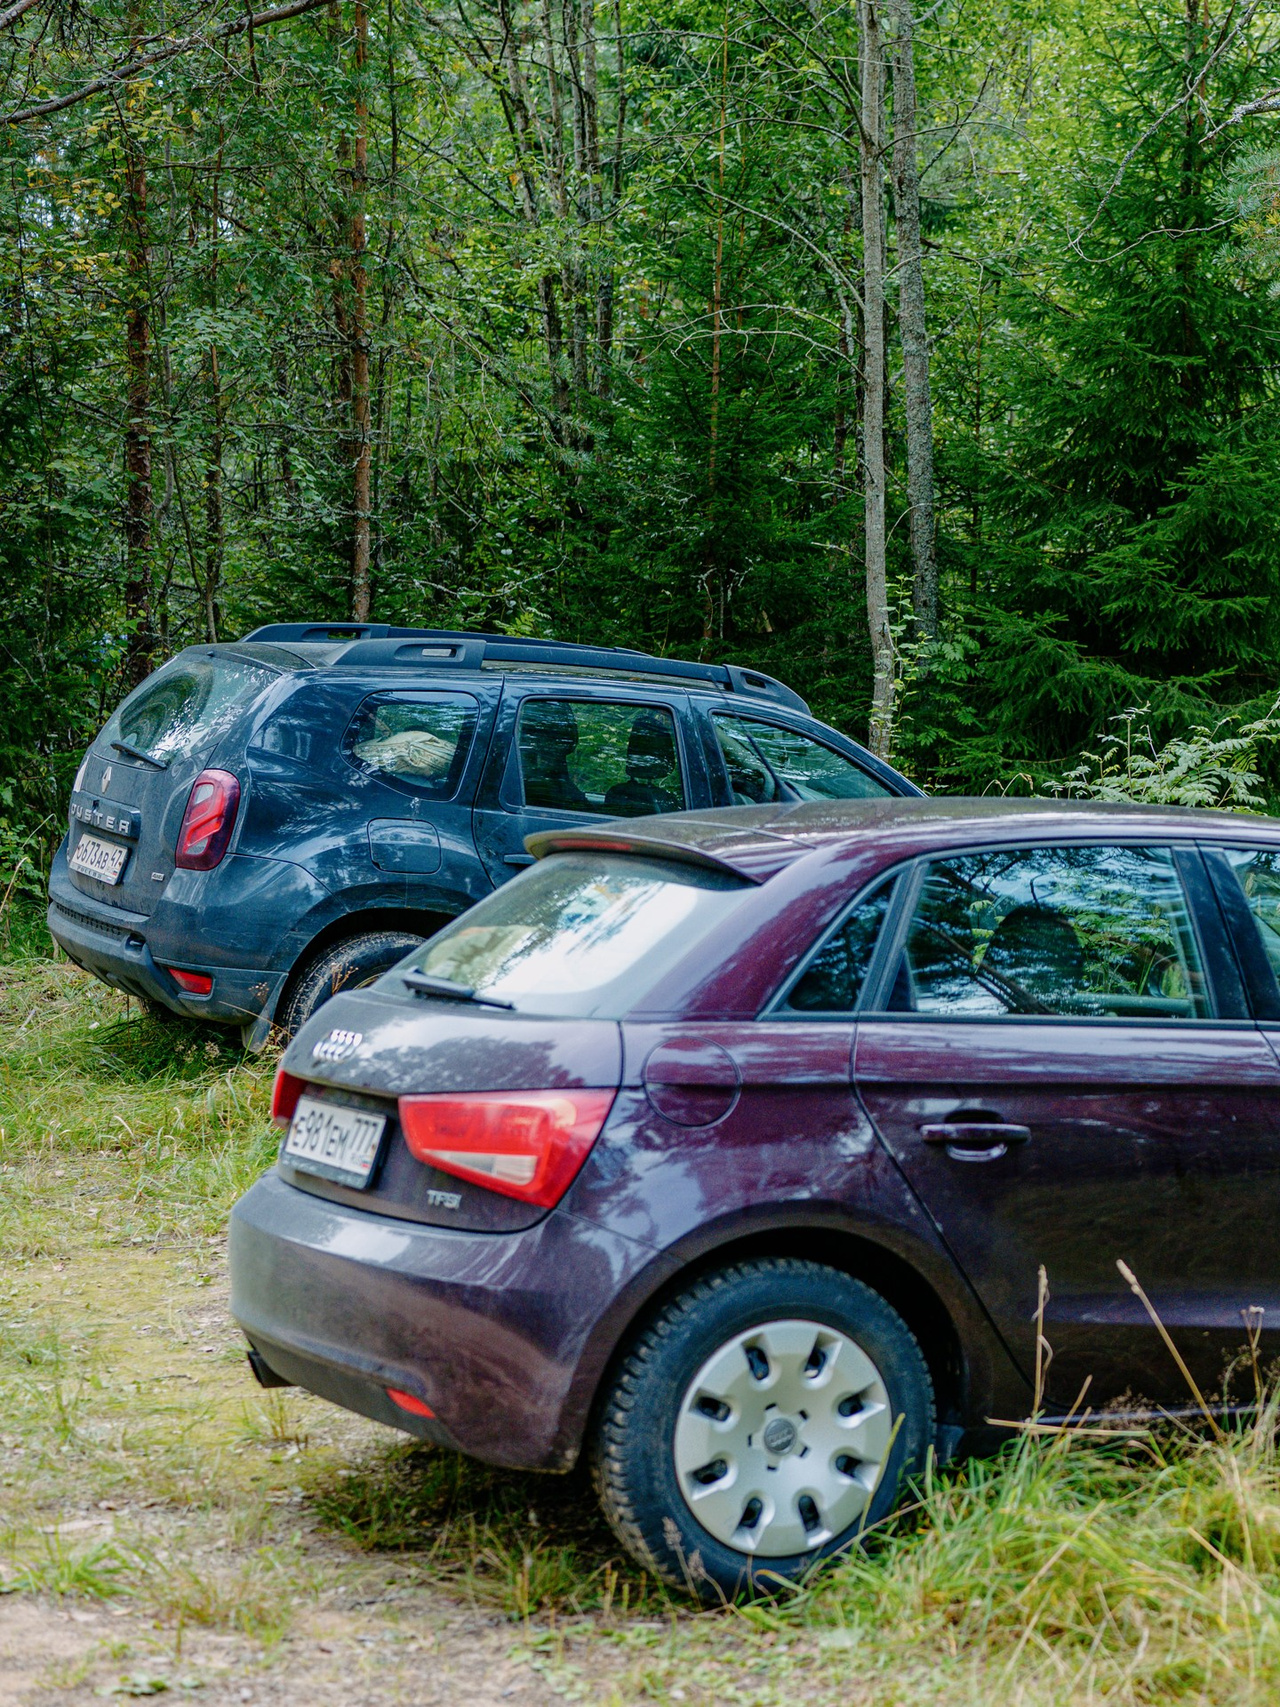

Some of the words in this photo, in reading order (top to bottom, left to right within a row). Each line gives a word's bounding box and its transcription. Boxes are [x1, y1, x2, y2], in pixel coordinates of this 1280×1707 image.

[71, 803, 130, 834] DUSTER
[111, 848, 123, 867] 47
[350, 1117, 378, 1154] 777
[426, 1189, 462, 1210] TFSI
